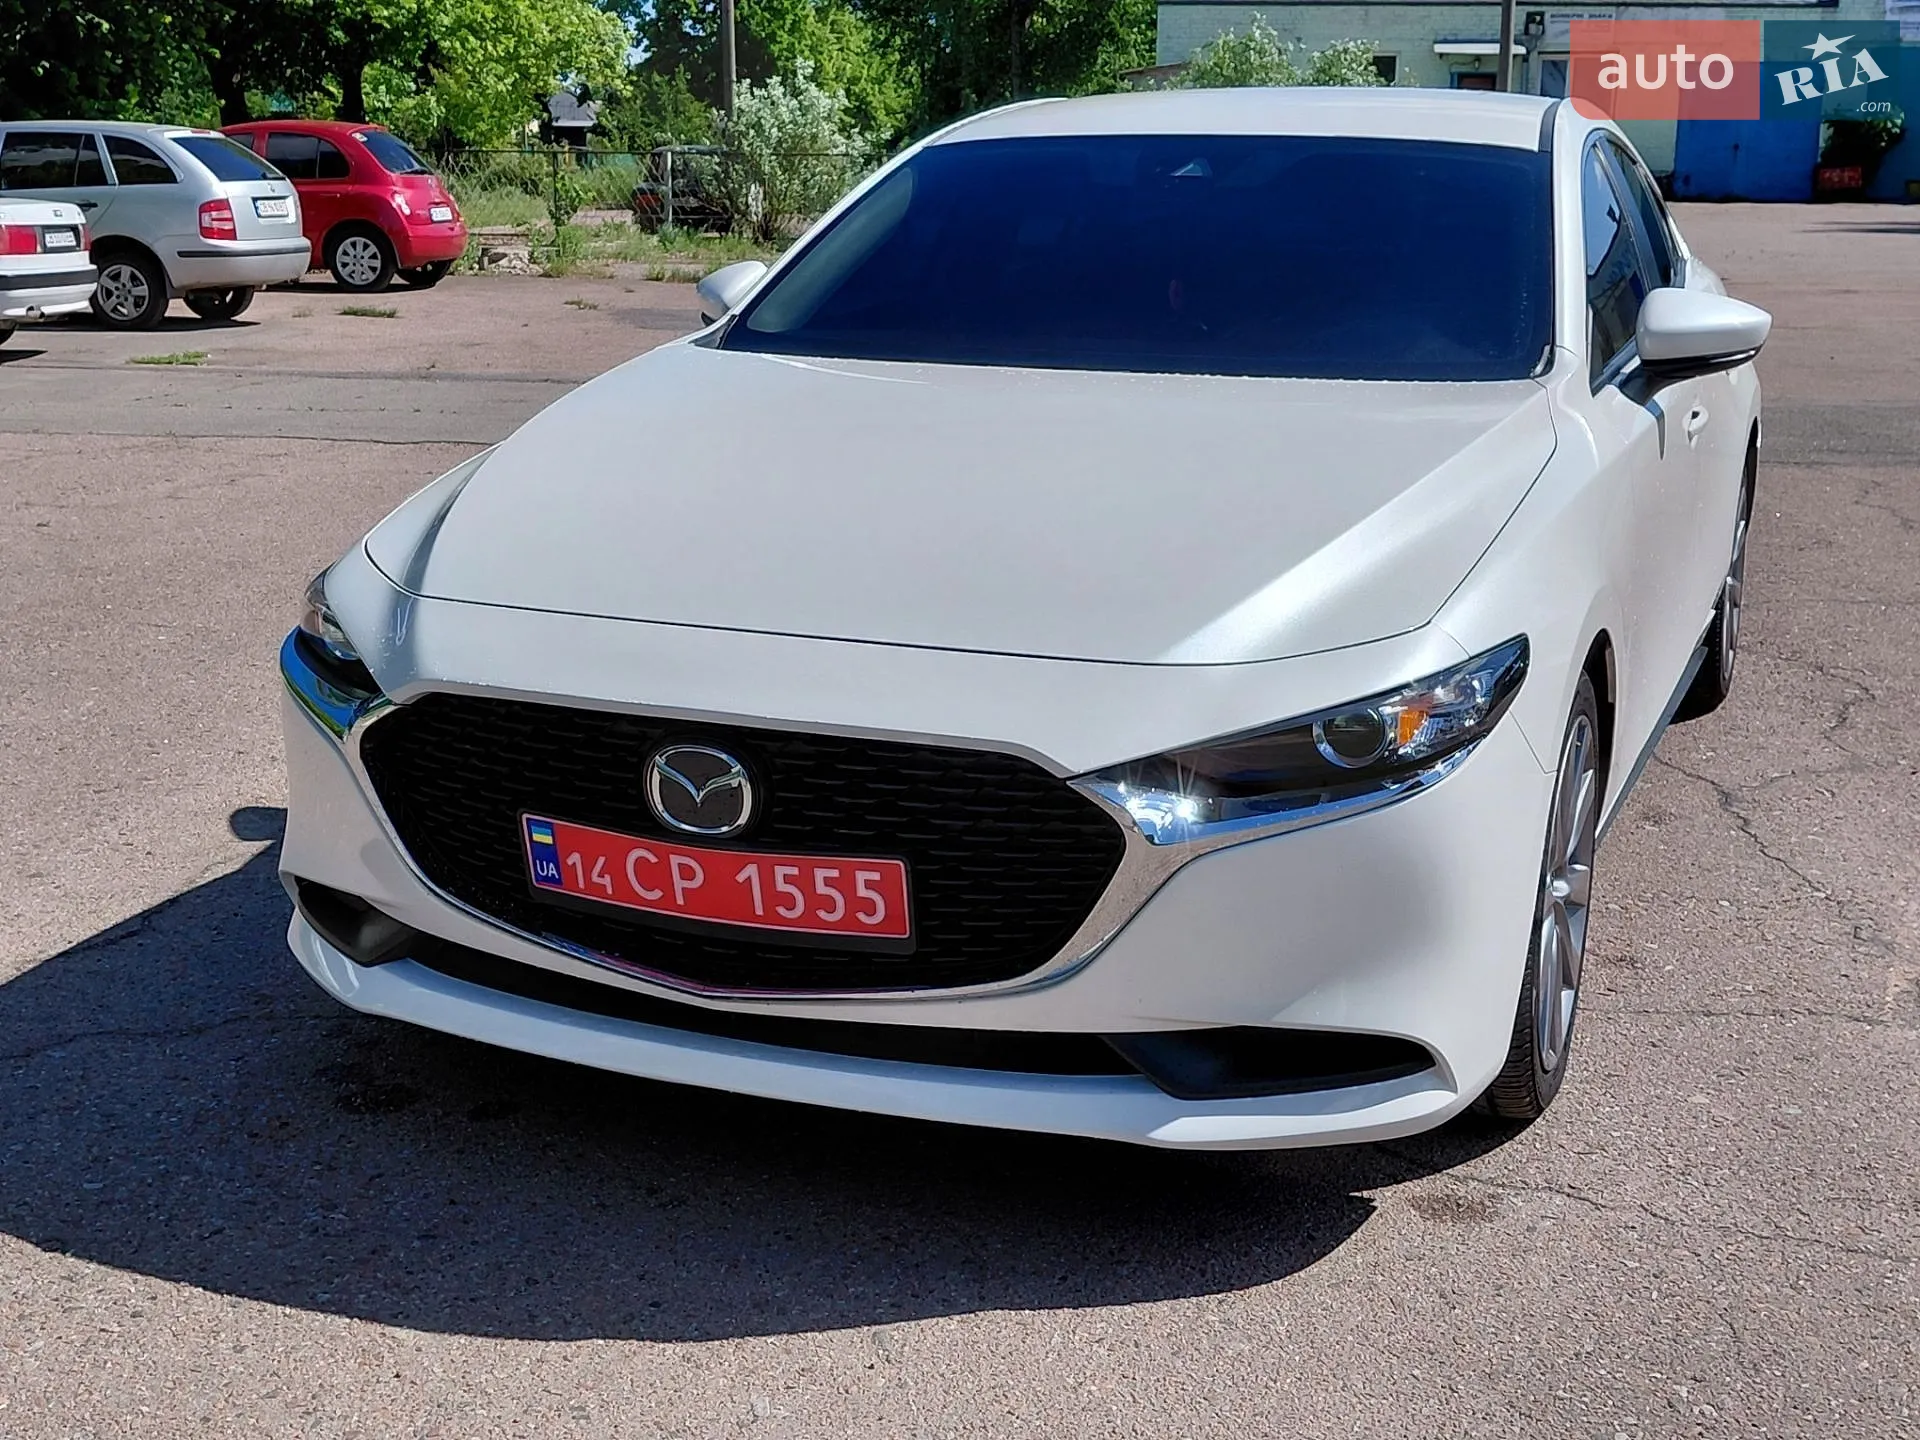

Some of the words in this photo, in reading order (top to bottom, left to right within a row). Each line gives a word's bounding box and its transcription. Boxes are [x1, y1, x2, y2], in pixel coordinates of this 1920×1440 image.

[536, 859, 559, 880] UA
[565, 852, 613, 895] 14
[625, 847, 706, 906] CP
[734, 863, 887, 926] 1555
